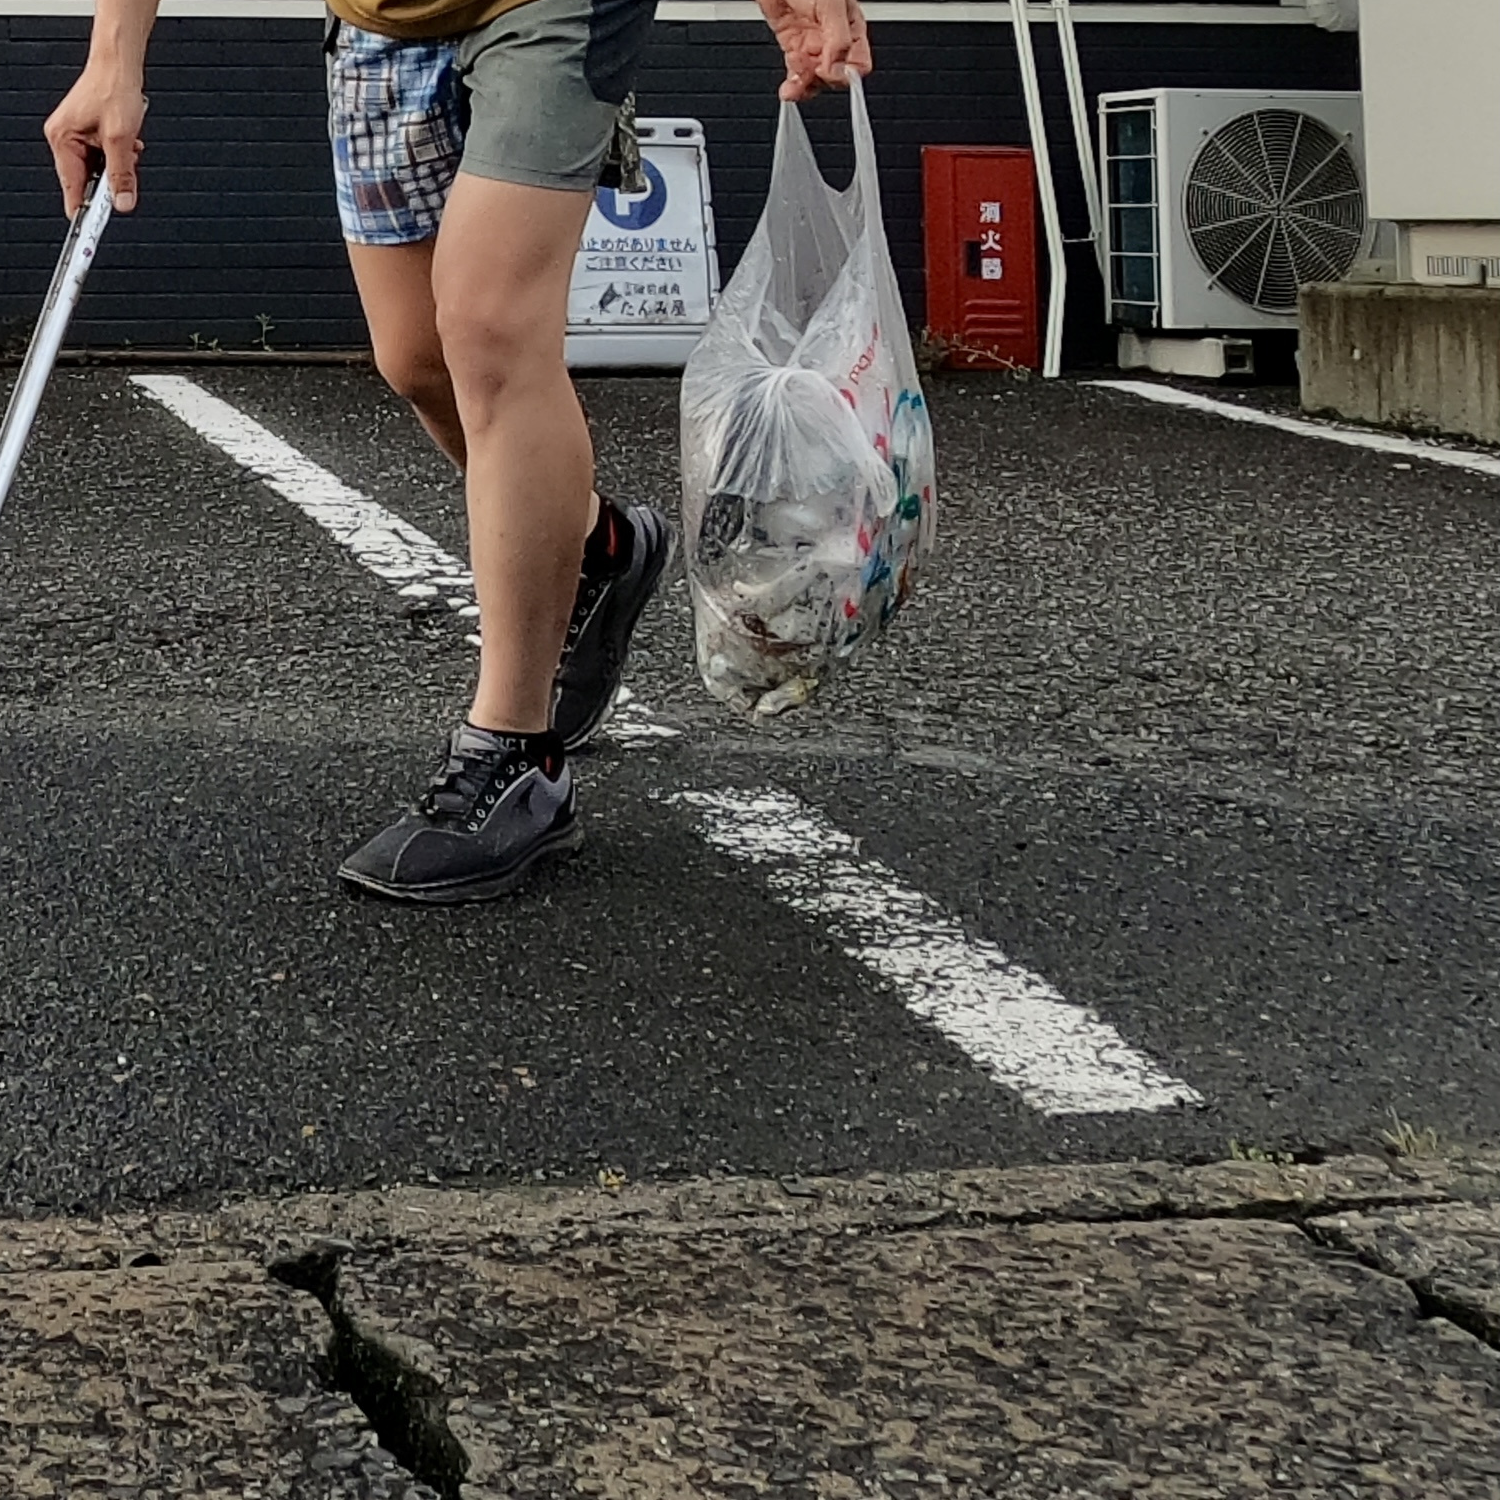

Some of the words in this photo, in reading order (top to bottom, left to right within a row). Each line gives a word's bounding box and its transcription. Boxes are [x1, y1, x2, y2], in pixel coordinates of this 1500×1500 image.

[580, 237, 697, 252] 止めがありません
[586, 255, 683, 271] ご注意ください
